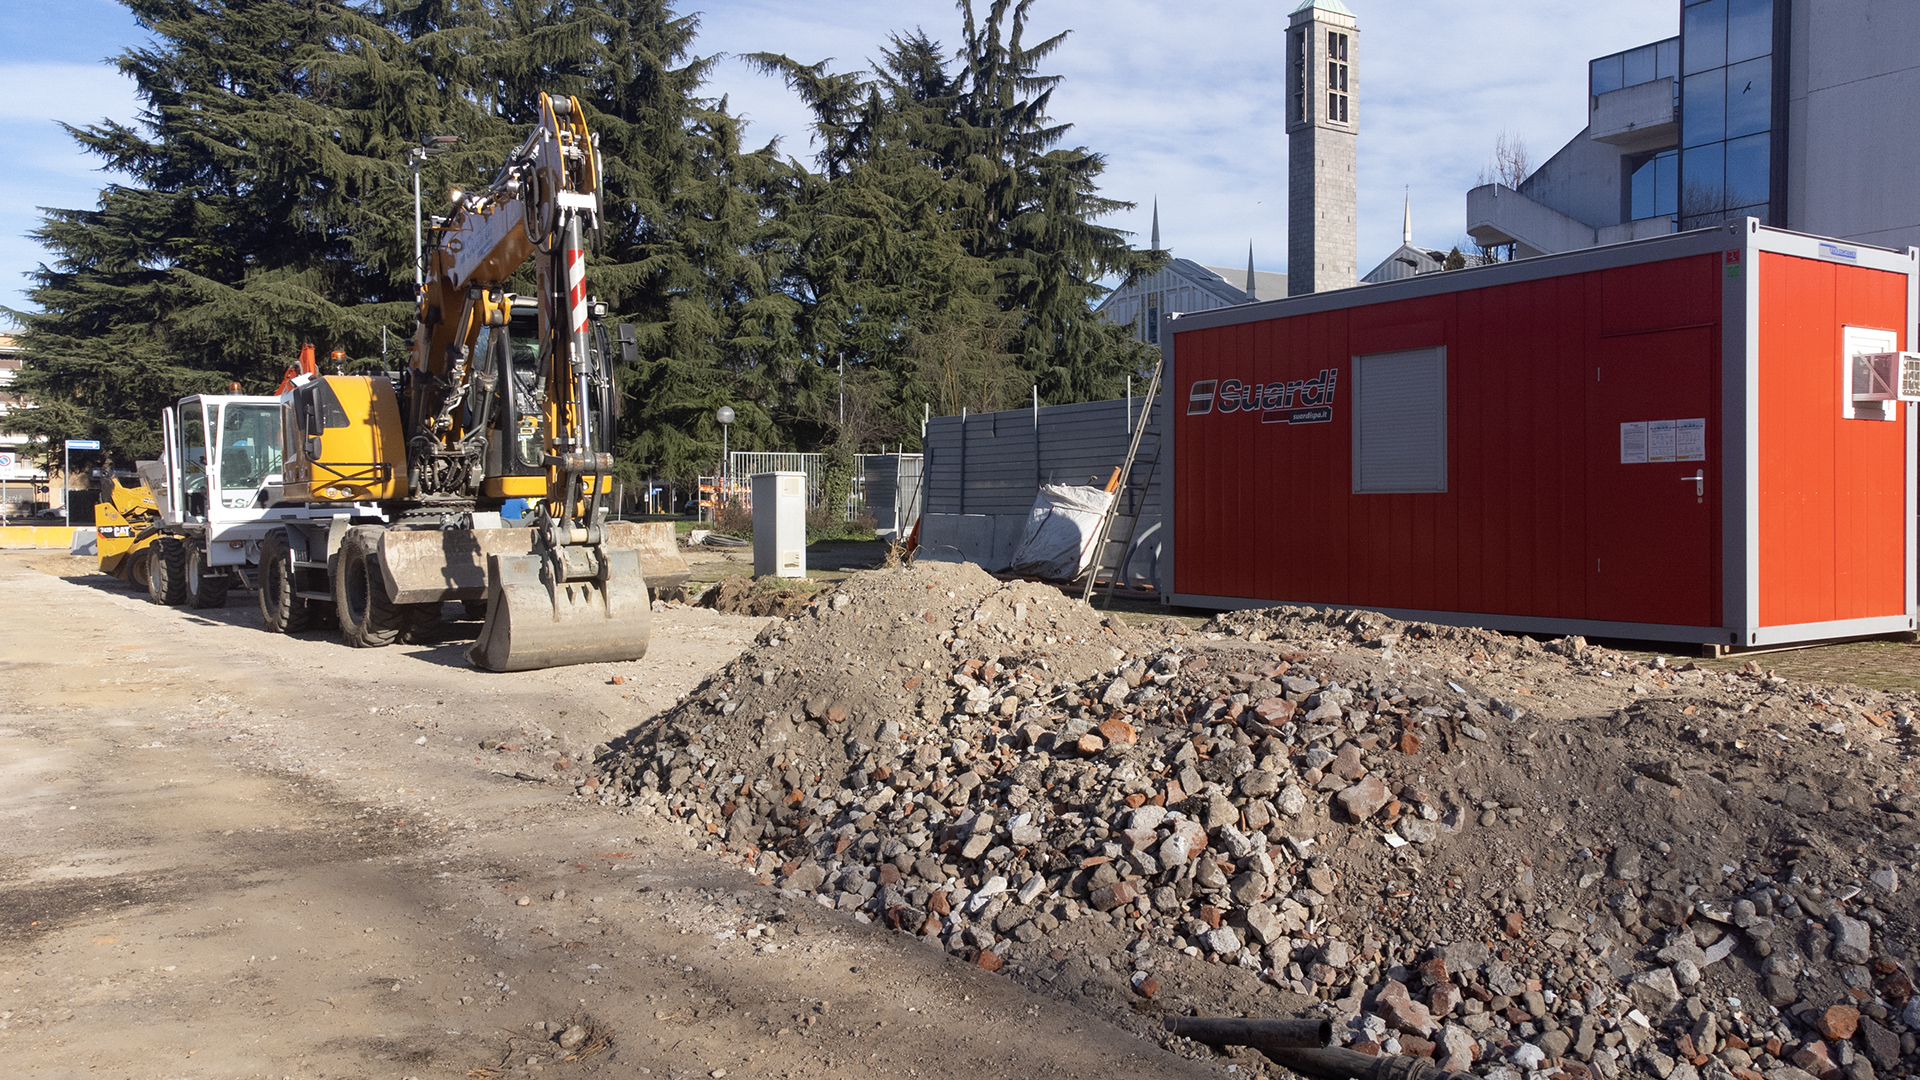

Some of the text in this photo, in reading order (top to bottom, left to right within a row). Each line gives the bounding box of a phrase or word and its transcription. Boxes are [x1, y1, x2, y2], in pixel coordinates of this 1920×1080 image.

[1217, 368, 1338, 413] Suardi
[1293, 411, 1327, 420] suardispa.it
[113, 526, 130, 537] CAT
